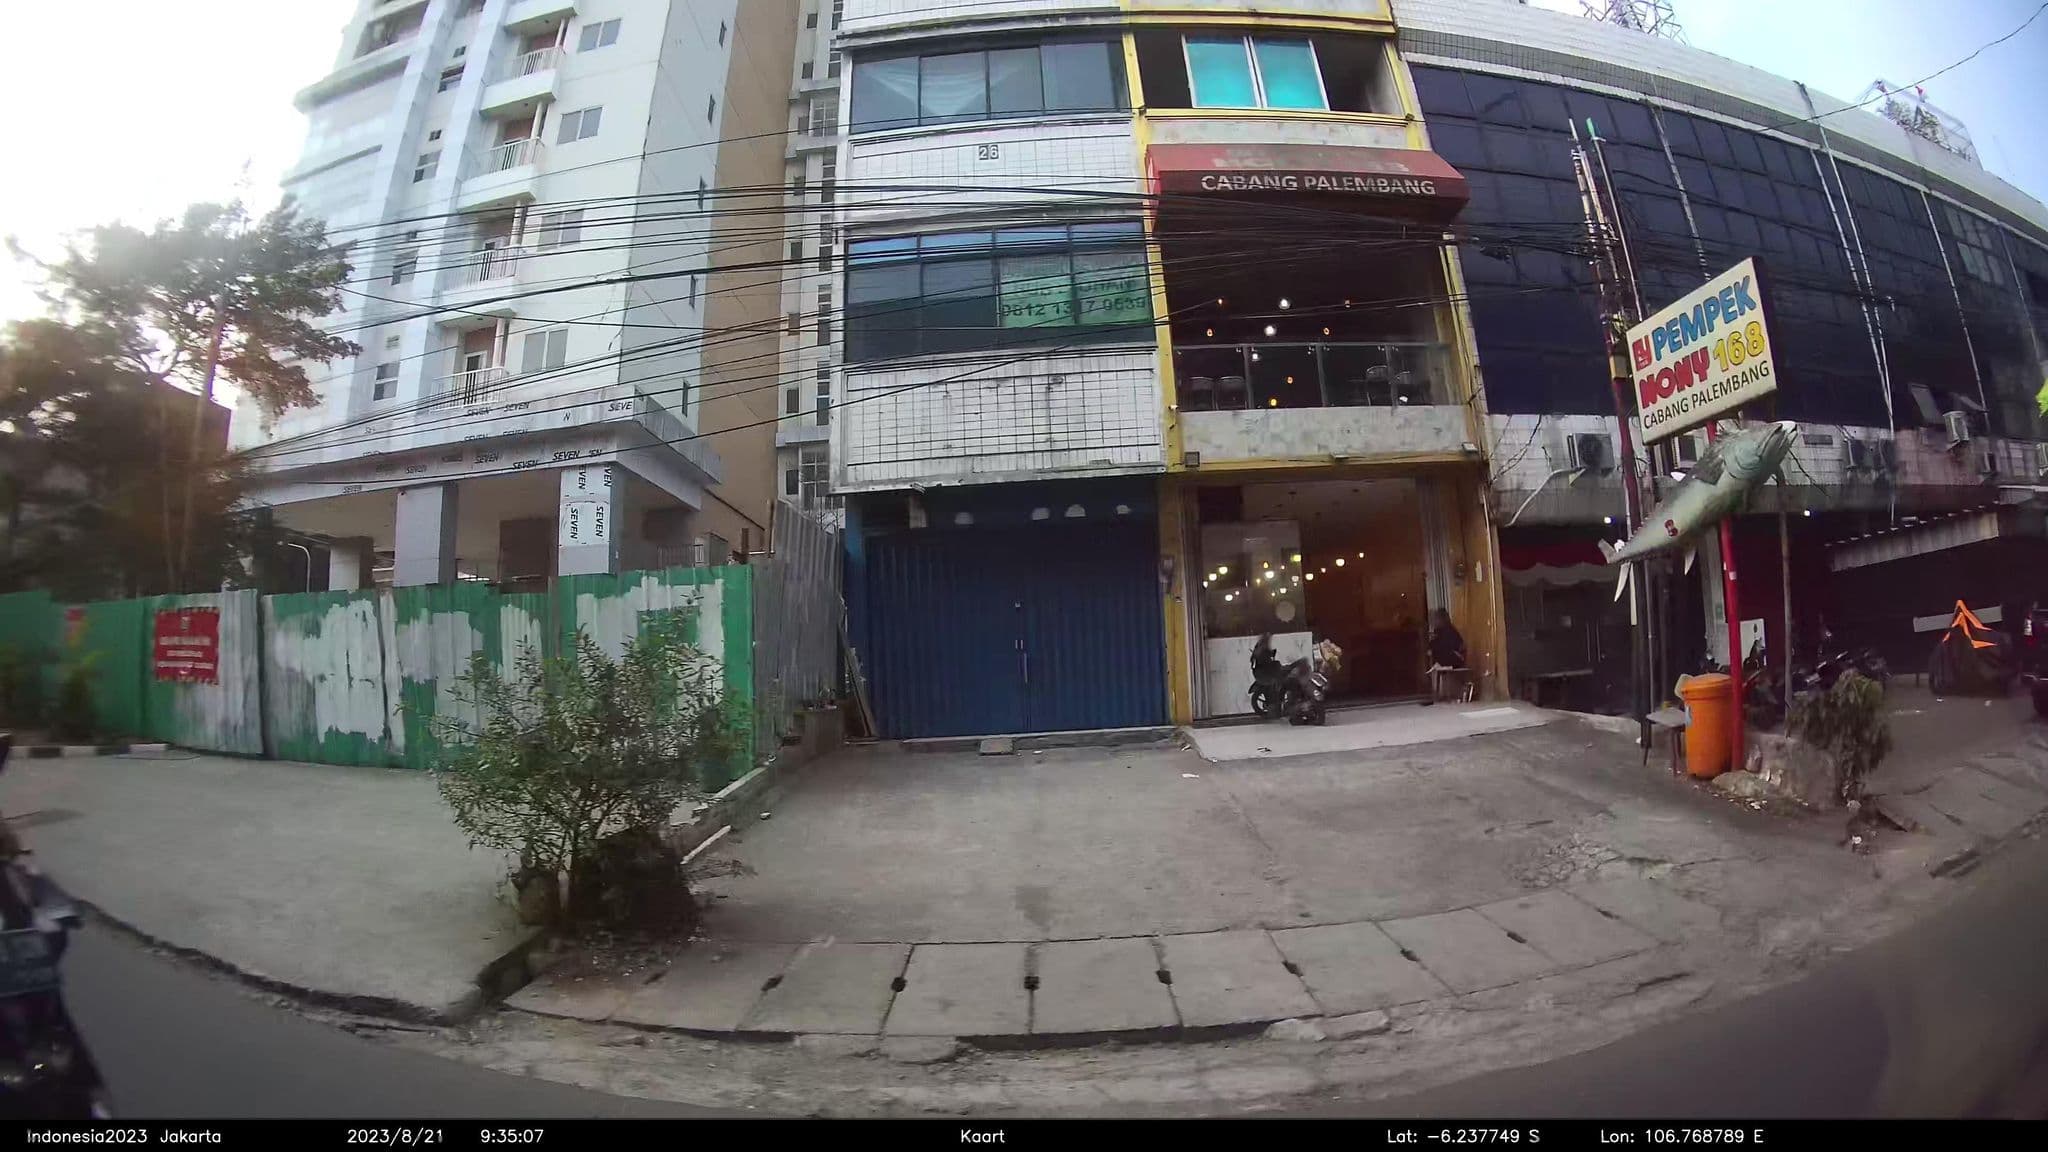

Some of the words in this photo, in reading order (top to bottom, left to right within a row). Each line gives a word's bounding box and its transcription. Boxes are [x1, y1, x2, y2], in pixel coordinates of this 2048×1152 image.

[979, 145, 999, 160] 26
[1200, 175, 1298, 191] CABANG
[1304, 177, 1437, 196] PALEMBANG
[1652, 276, 1756, 361] PEMPEK
[1639, 346, 1710, 409] NONY
[1713, 320, 1766, 373] 168
[1643, 400, 1690, 430] CABANG
[1692, 361, 1769, 408] PALEMBANG
[474, 452, 500, 464] SEVEN
[553, 450, 580, 461] SEVEN
[570, 508, 579, 539] SEVEN
[596, 506, 604, 537] SEVEN
